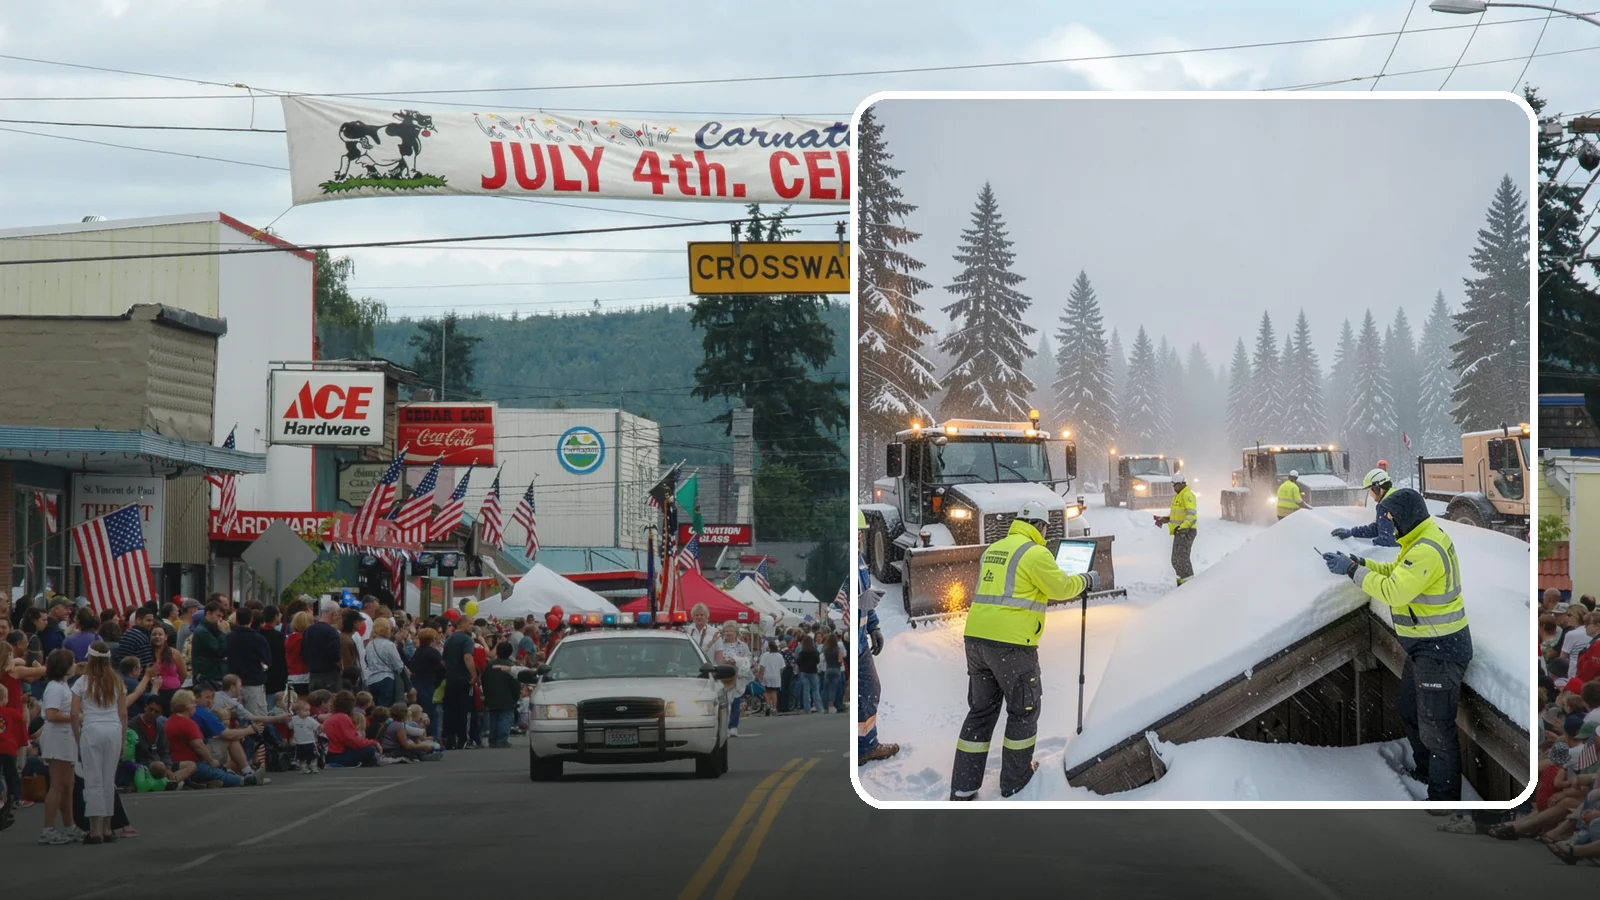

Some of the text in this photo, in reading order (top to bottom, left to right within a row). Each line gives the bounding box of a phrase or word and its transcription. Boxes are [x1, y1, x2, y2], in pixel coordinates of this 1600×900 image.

[481, 141, 605, 193] JULY
[632, 150, 746, 198] 4th.
[697, 254, 850, 280] CROSSWA
[283, 380, 373, 420] ACE
[405, 409, 485, 421] CEDAR LOG
[283, 421, 371, 437] Hardware
[95, 485, 124, 494] Vincent
[126, 486, 135, 494] de
[138, 486, 155, 495] Paul
[81, 503, 154, 522] THT
[688, 526, 741, 535] CRNATION
[699, 535, 730, 543] GLASS
